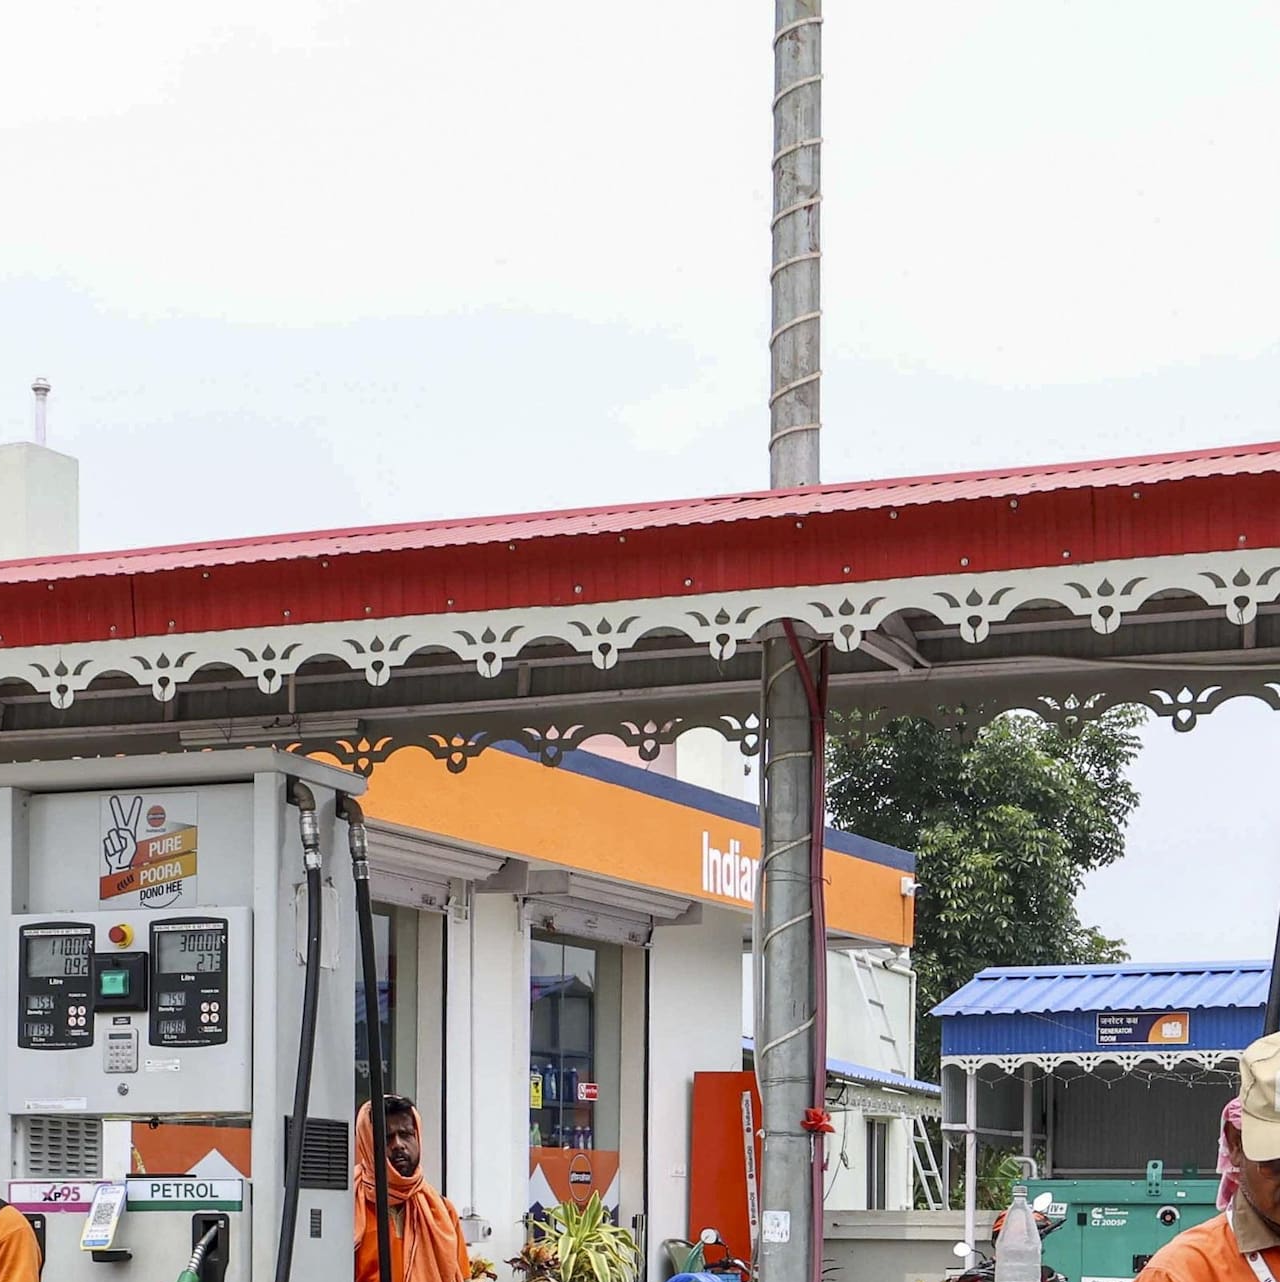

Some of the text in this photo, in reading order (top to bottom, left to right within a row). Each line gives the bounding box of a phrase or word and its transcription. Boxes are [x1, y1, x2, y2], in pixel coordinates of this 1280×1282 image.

[148, 836, 182, 857] PURE
[140, 862, 182, 885] POORA
[140, 880, 182, 900] DONO HEE
[150, 1183, 219, 1199] PETROL
